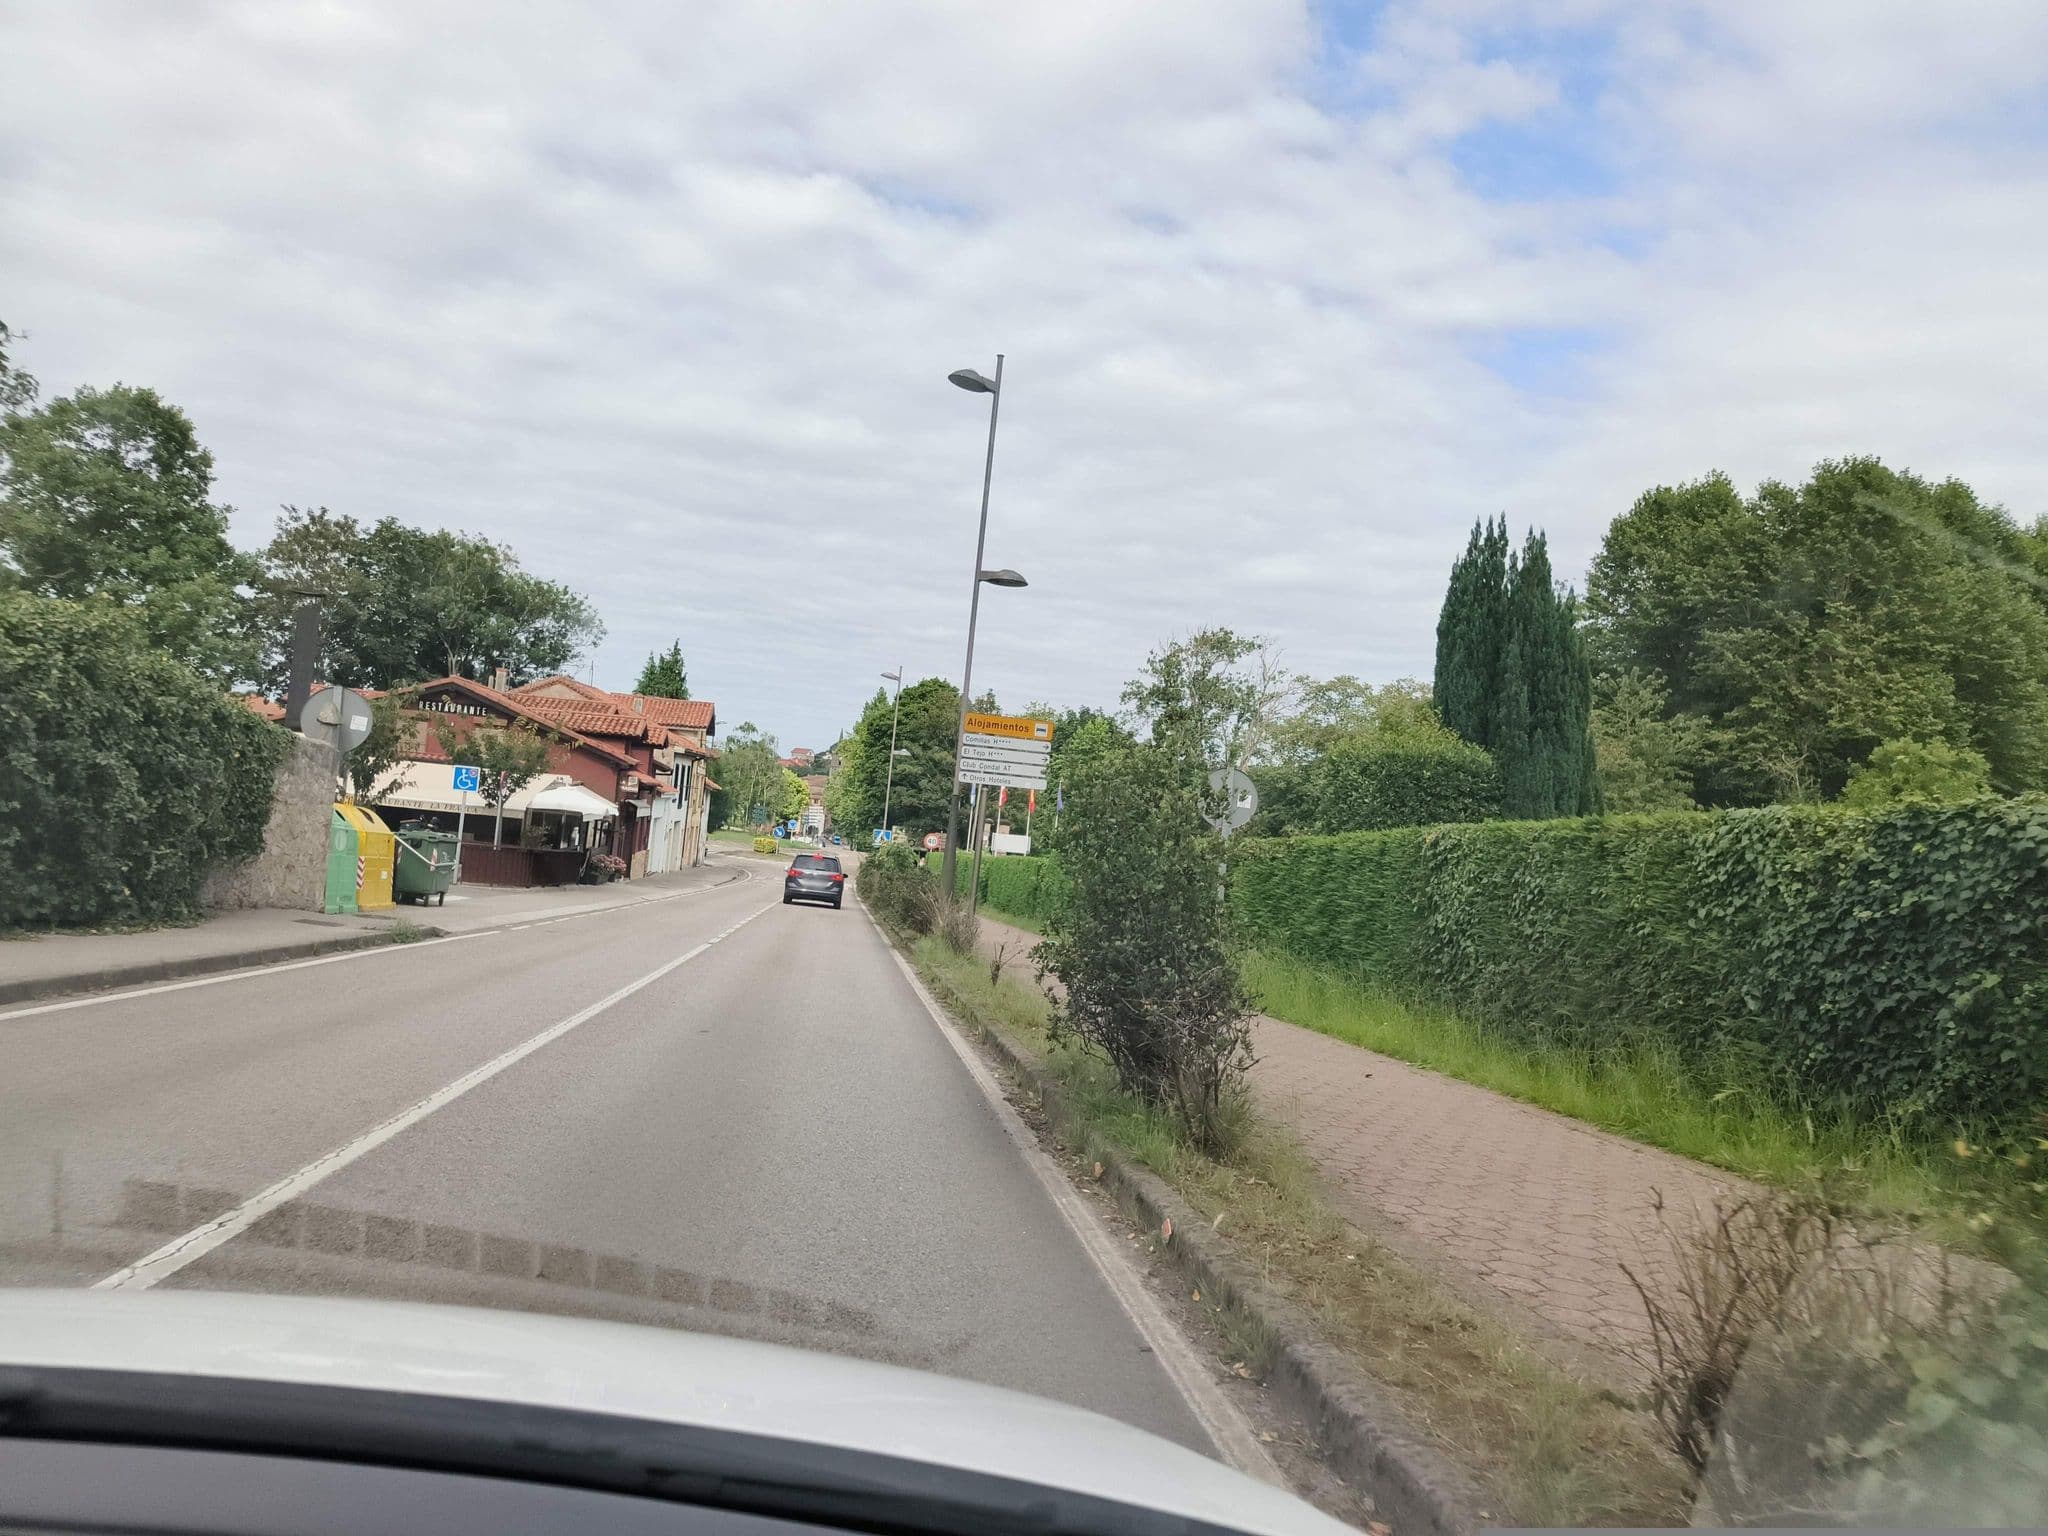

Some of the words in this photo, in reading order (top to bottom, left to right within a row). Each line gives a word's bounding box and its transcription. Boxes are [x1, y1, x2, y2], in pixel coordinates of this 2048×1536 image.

[419, 701, 487, 716] RESTAURANTE
[967, 718, 1030, 733] Alojamientos
[965, 735, 991, 744] Comillas
[963, 747, 970, 755] El
[973, 748, 985, 757] Tejo
[962, 760, 976, 768] Club
[979, 762, 1000, 771] Condal
[969, 775, 986, 783] Otros
[988, 777, 1011, 785] Hoteles
